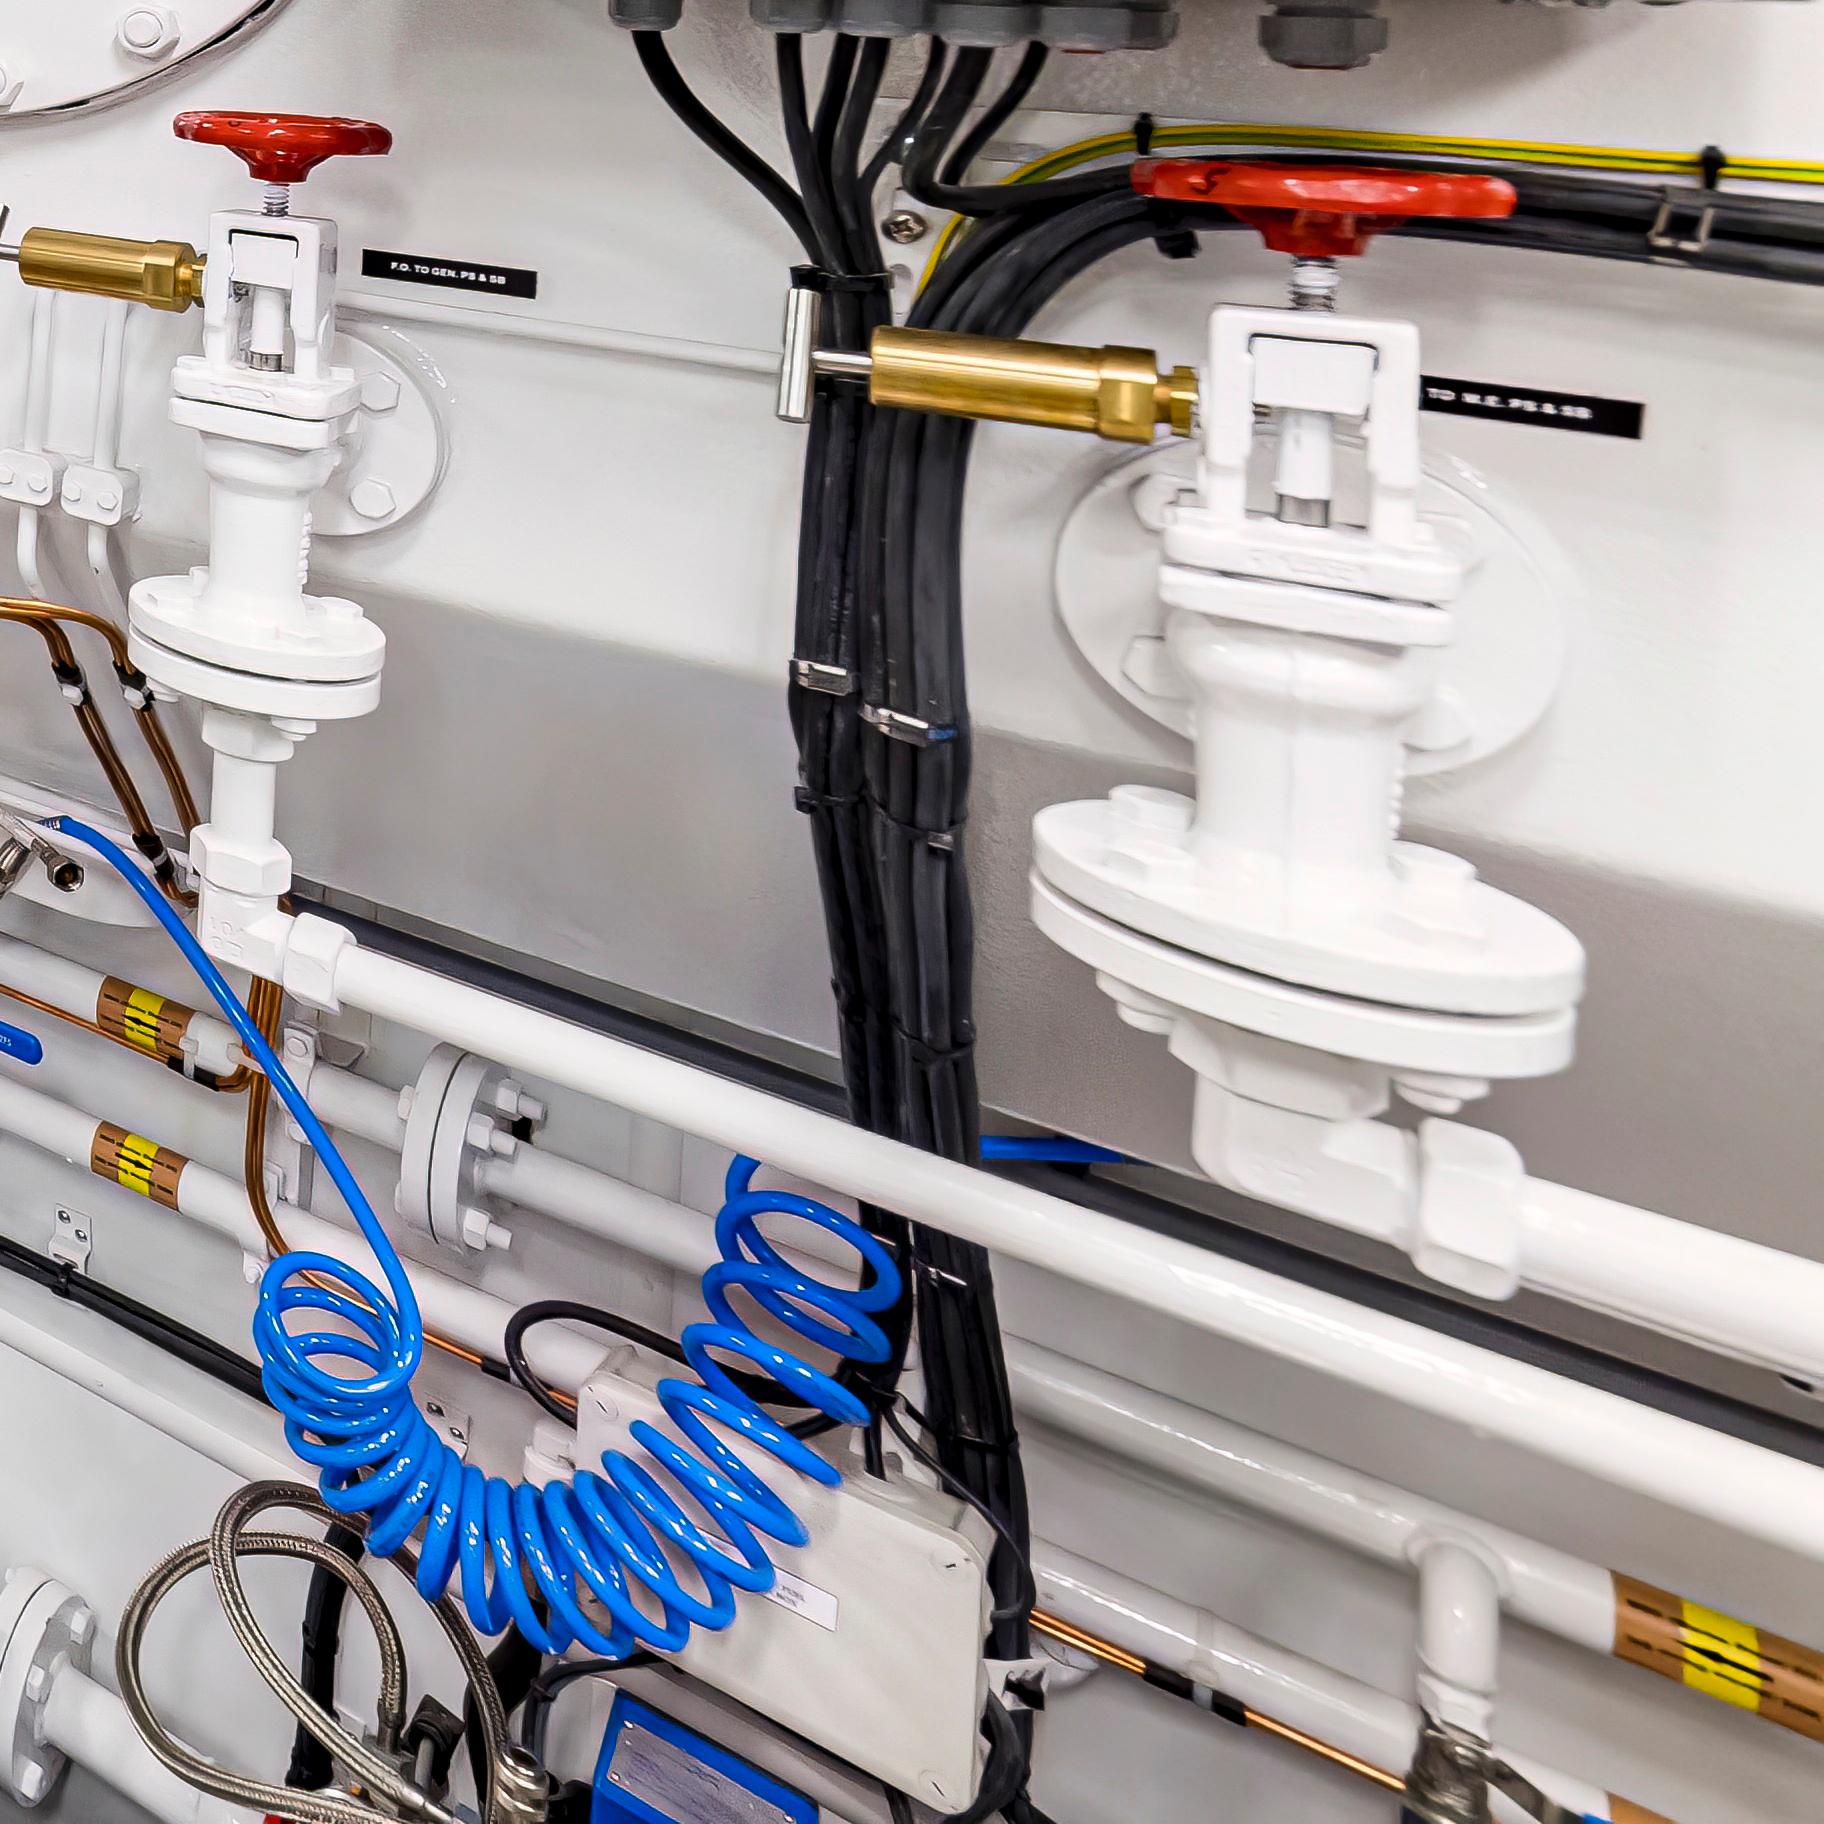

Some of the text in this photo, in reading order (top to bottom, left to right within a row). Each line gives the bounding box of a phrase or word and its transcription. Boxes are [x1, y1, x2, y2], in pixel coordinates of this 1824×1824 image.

[390, 261, 412, 272] F.O.
[414, 264, 429, 274] TO
[431, 267, 459, 279] GEN.
